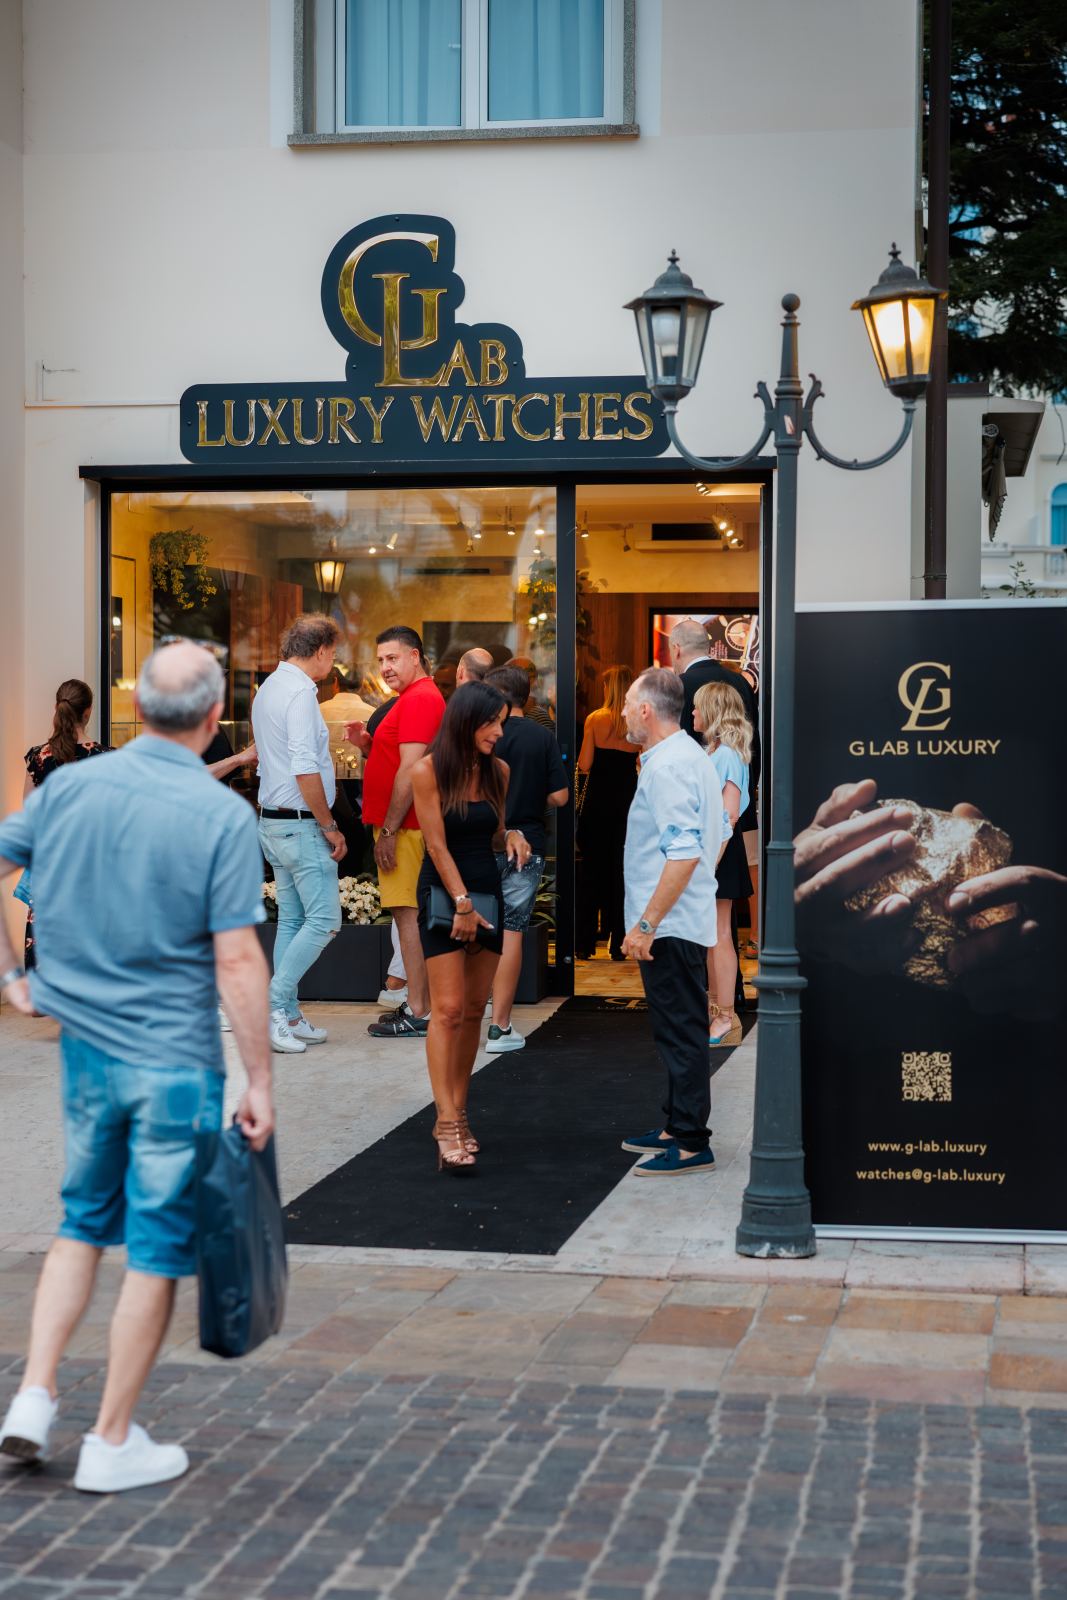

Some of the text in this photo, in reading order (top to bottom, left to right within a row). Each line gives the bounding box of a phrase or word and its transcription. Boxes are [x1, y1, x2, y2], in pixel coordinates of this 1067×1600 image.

[196, 391, 655, 447] LUXURY WATCHES
[916, 739, 1001, 755] LUXURY
[867, 1140, 988, 1156] www.g-lab.luxury
[856, 1167, 1006, 1185] watches@g-lab.luxury
